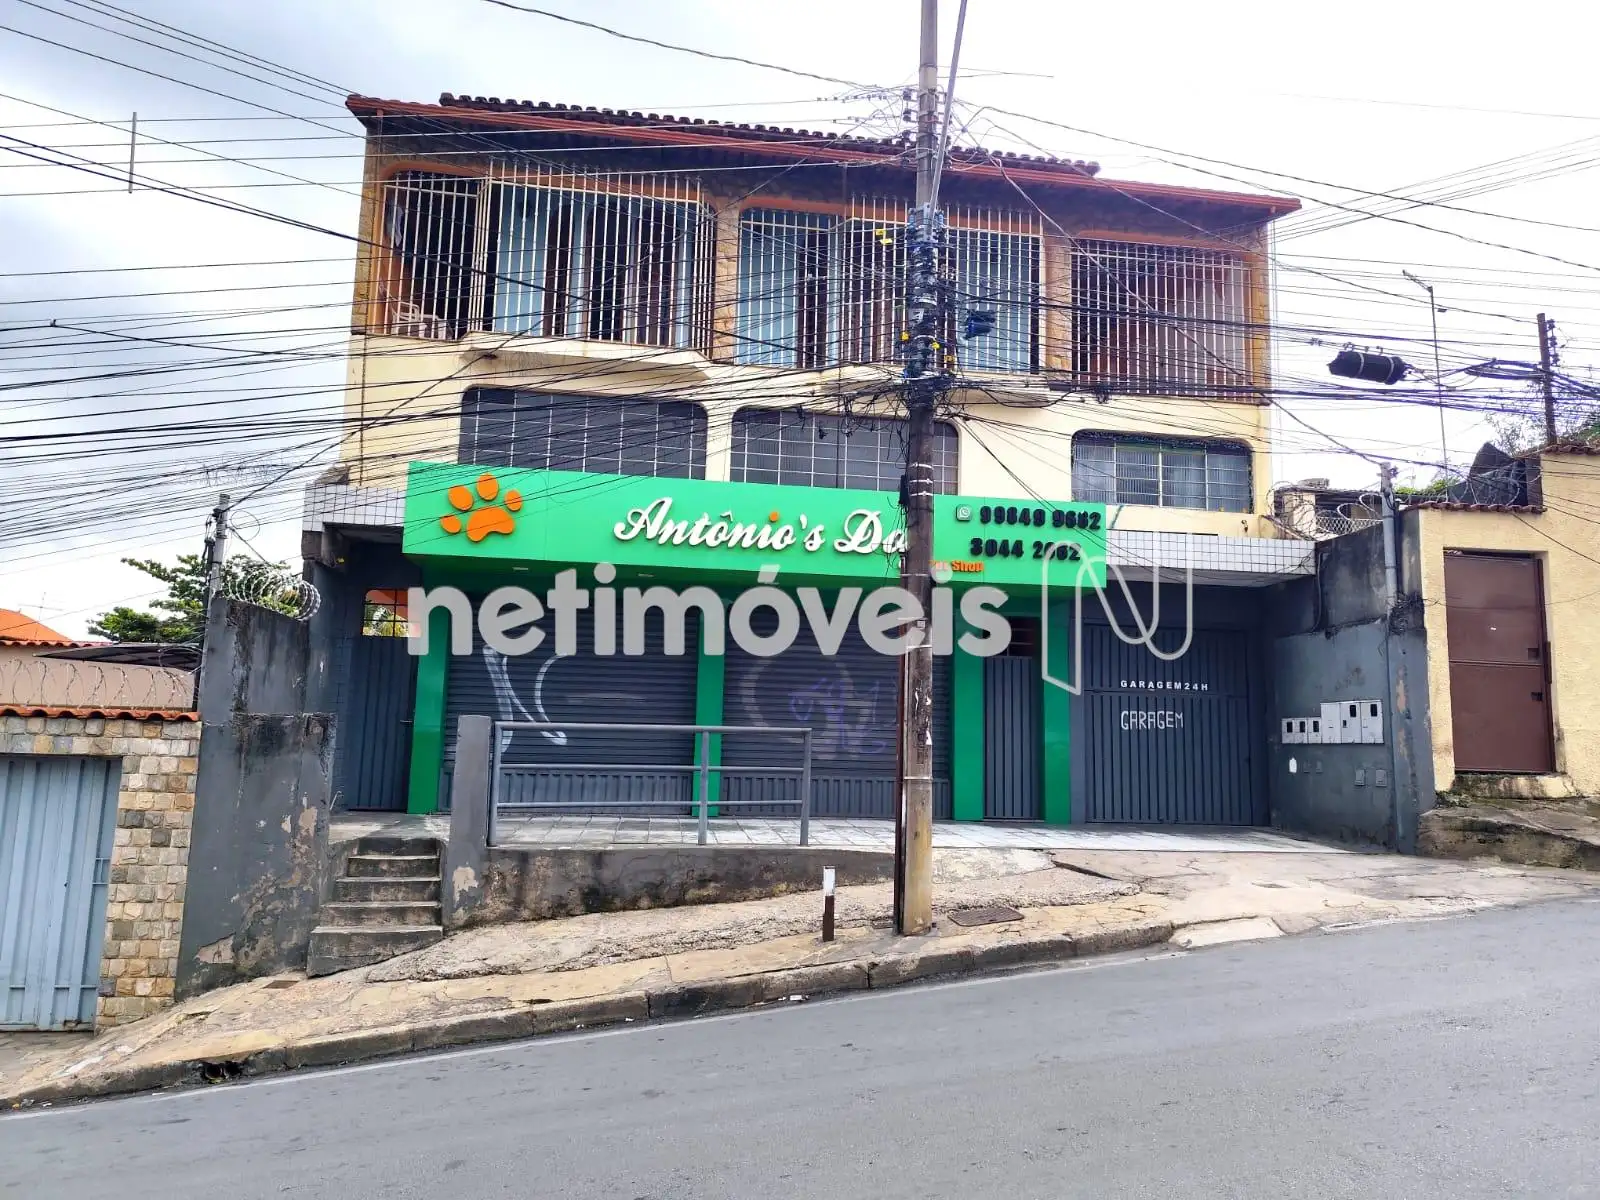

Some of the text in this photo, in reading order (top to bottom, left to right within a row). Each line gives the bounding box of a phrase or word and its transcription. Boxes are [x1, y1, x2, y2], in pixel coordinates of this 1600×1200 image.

[613, 496, 826, 552] Antônio's
[970, 537, 1024, 558] 3044
[951, 560, 984, 573] Shop
[1120, 710, 1184, 730] GARAGEM
